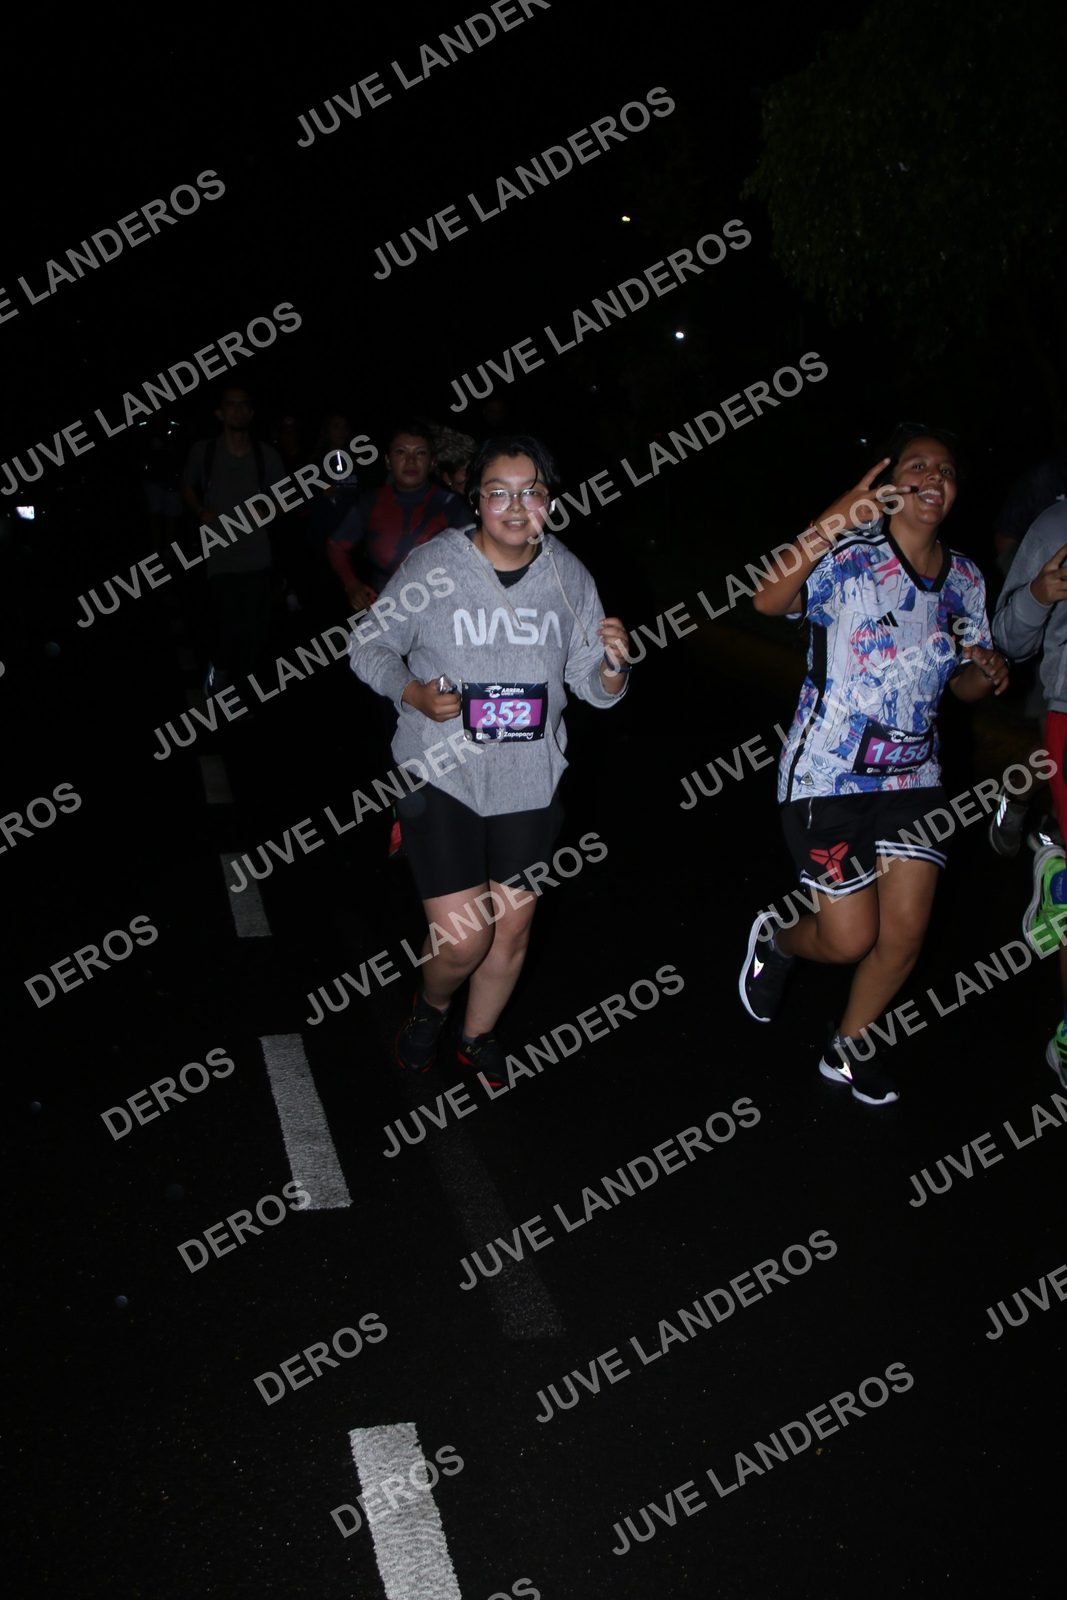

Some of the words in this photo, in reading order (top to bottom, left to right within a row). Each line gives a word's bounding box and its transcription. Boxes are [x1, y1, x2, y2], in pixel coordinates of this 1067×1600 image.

[453, 607, 562, 648] NASA
[482, 701, 532, 726] 352
[872, 742, 930, 763] 1458
